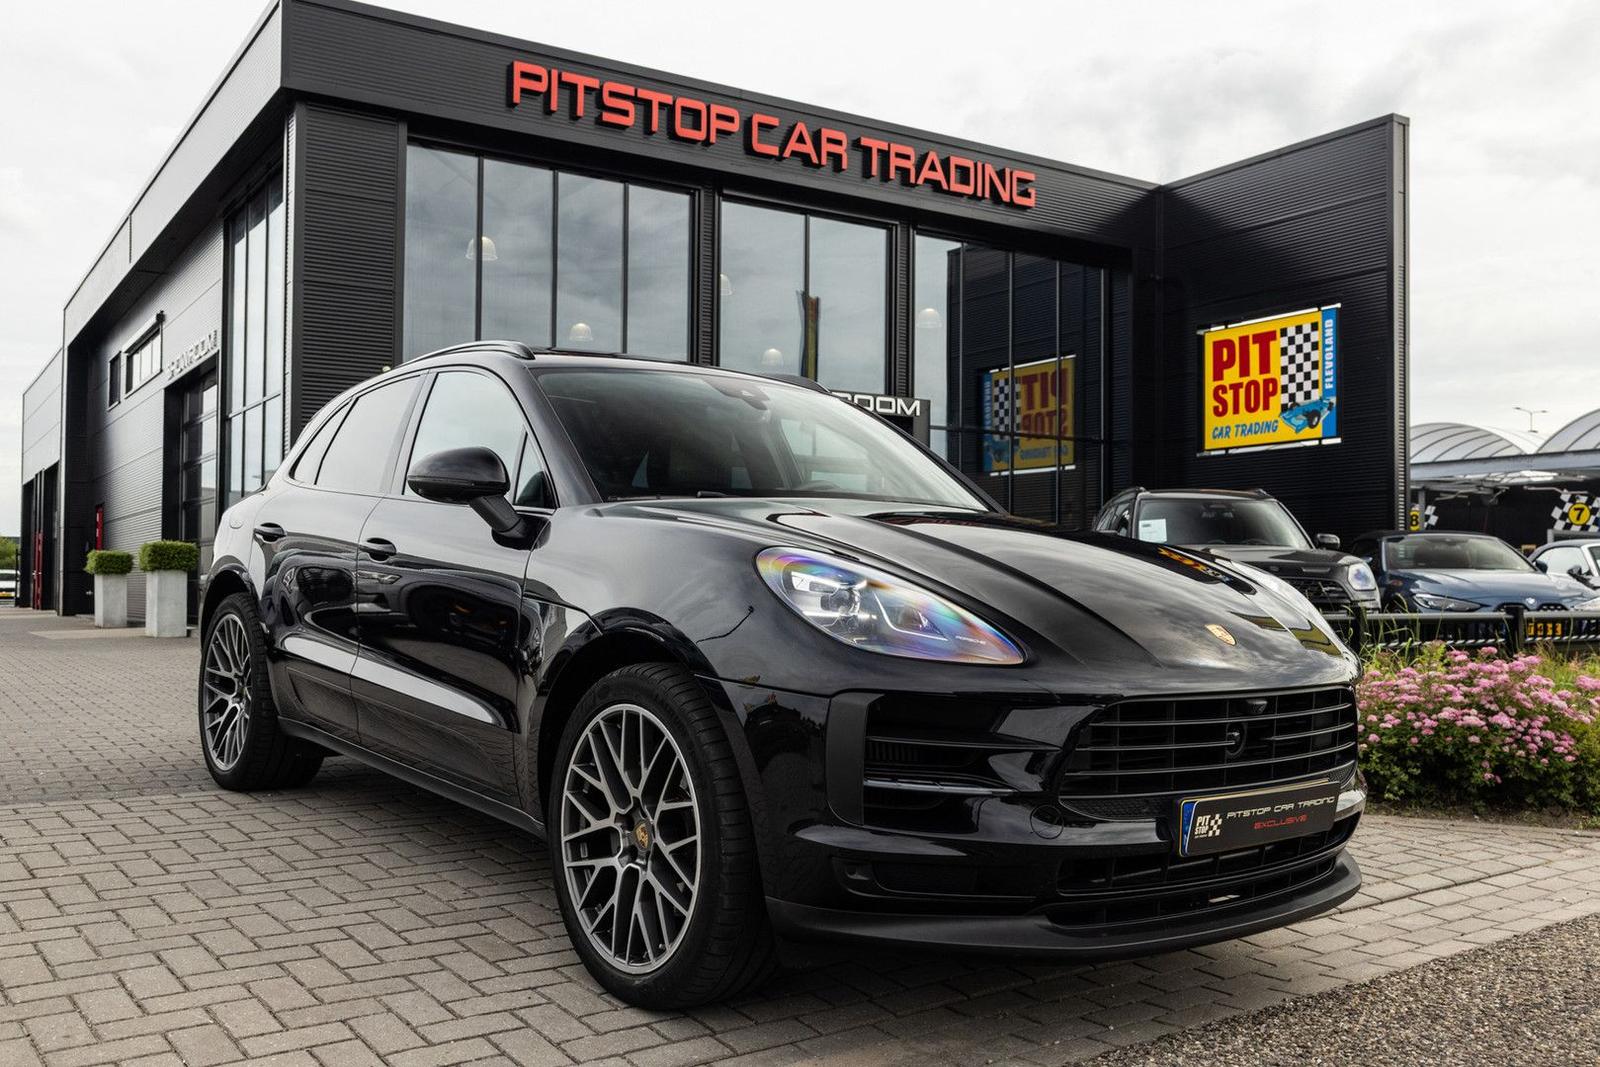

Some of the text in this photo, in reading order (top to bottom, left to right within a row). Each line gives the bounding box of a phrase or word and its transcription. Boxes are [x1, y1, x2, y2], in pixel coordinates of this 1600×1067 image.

[512, 60, 1036, 207] PITSTOP CAR TRADING
[1212, 330, 1277, 382] PIT
[1324, 318, 1334, 389] FLEVOLAND
[831, 391, 920, 417] OOM
[1212, 377, 1278, 418] STOP
[1211, 420, 1279, 440] CAR TRADING
[1410, 513, 1419, 527] 8
[1573, 506, 1585, 521] 7
[1196, 815, 1211, 827] PIT
[1226, 806, 1272, 819] PITSTOP
[1273, 803, 1295, 813] CAR
[1194, 825, 1209, 835] STOP
